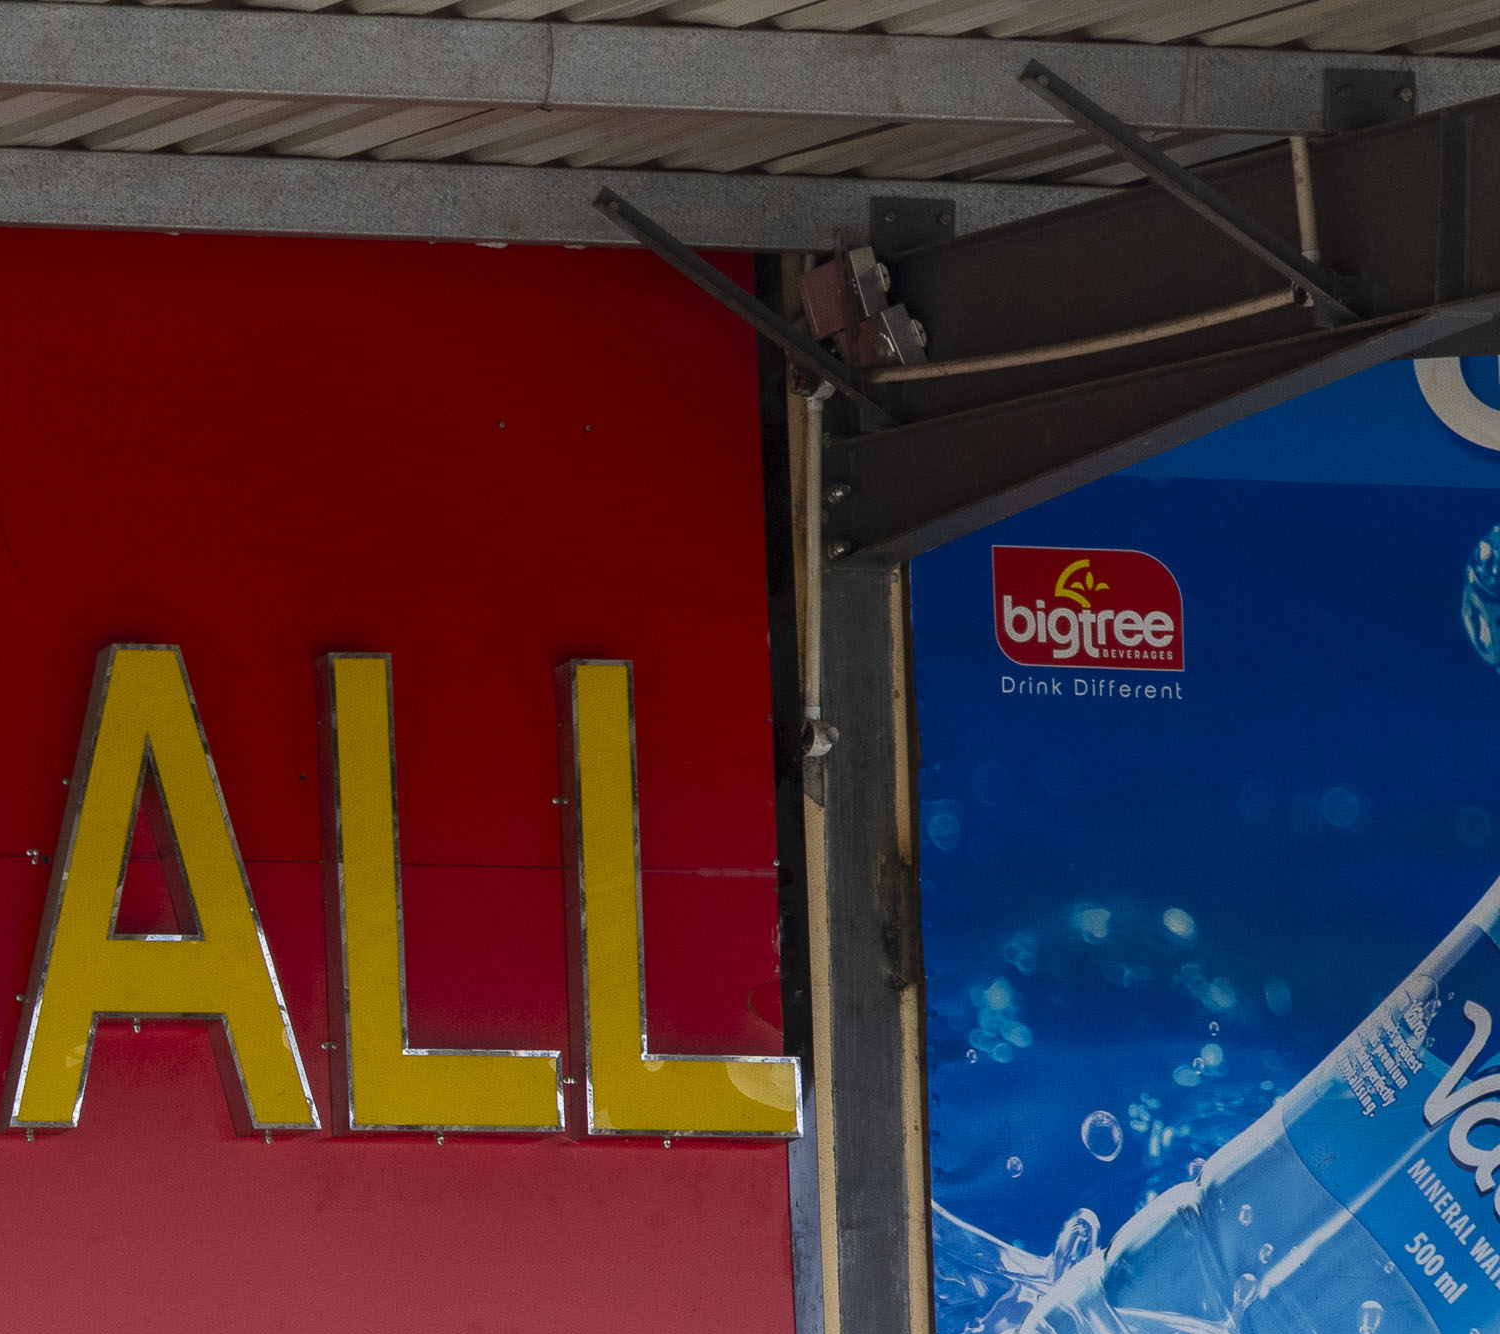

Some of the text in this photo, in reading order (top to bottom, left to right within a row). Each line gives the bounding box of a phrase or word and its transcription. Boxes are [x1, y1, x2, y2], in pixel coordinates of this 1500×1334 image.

[1002, 595, 1175, 660] bigtree
[1102, 648, 1174, 661] BEVERAGES
[1001, 675, 1183, 701] Drink Different
[1407, 1157, 1477, 1247] MINERAL
[1404, 1231, 1470, 1306] 500 ml
